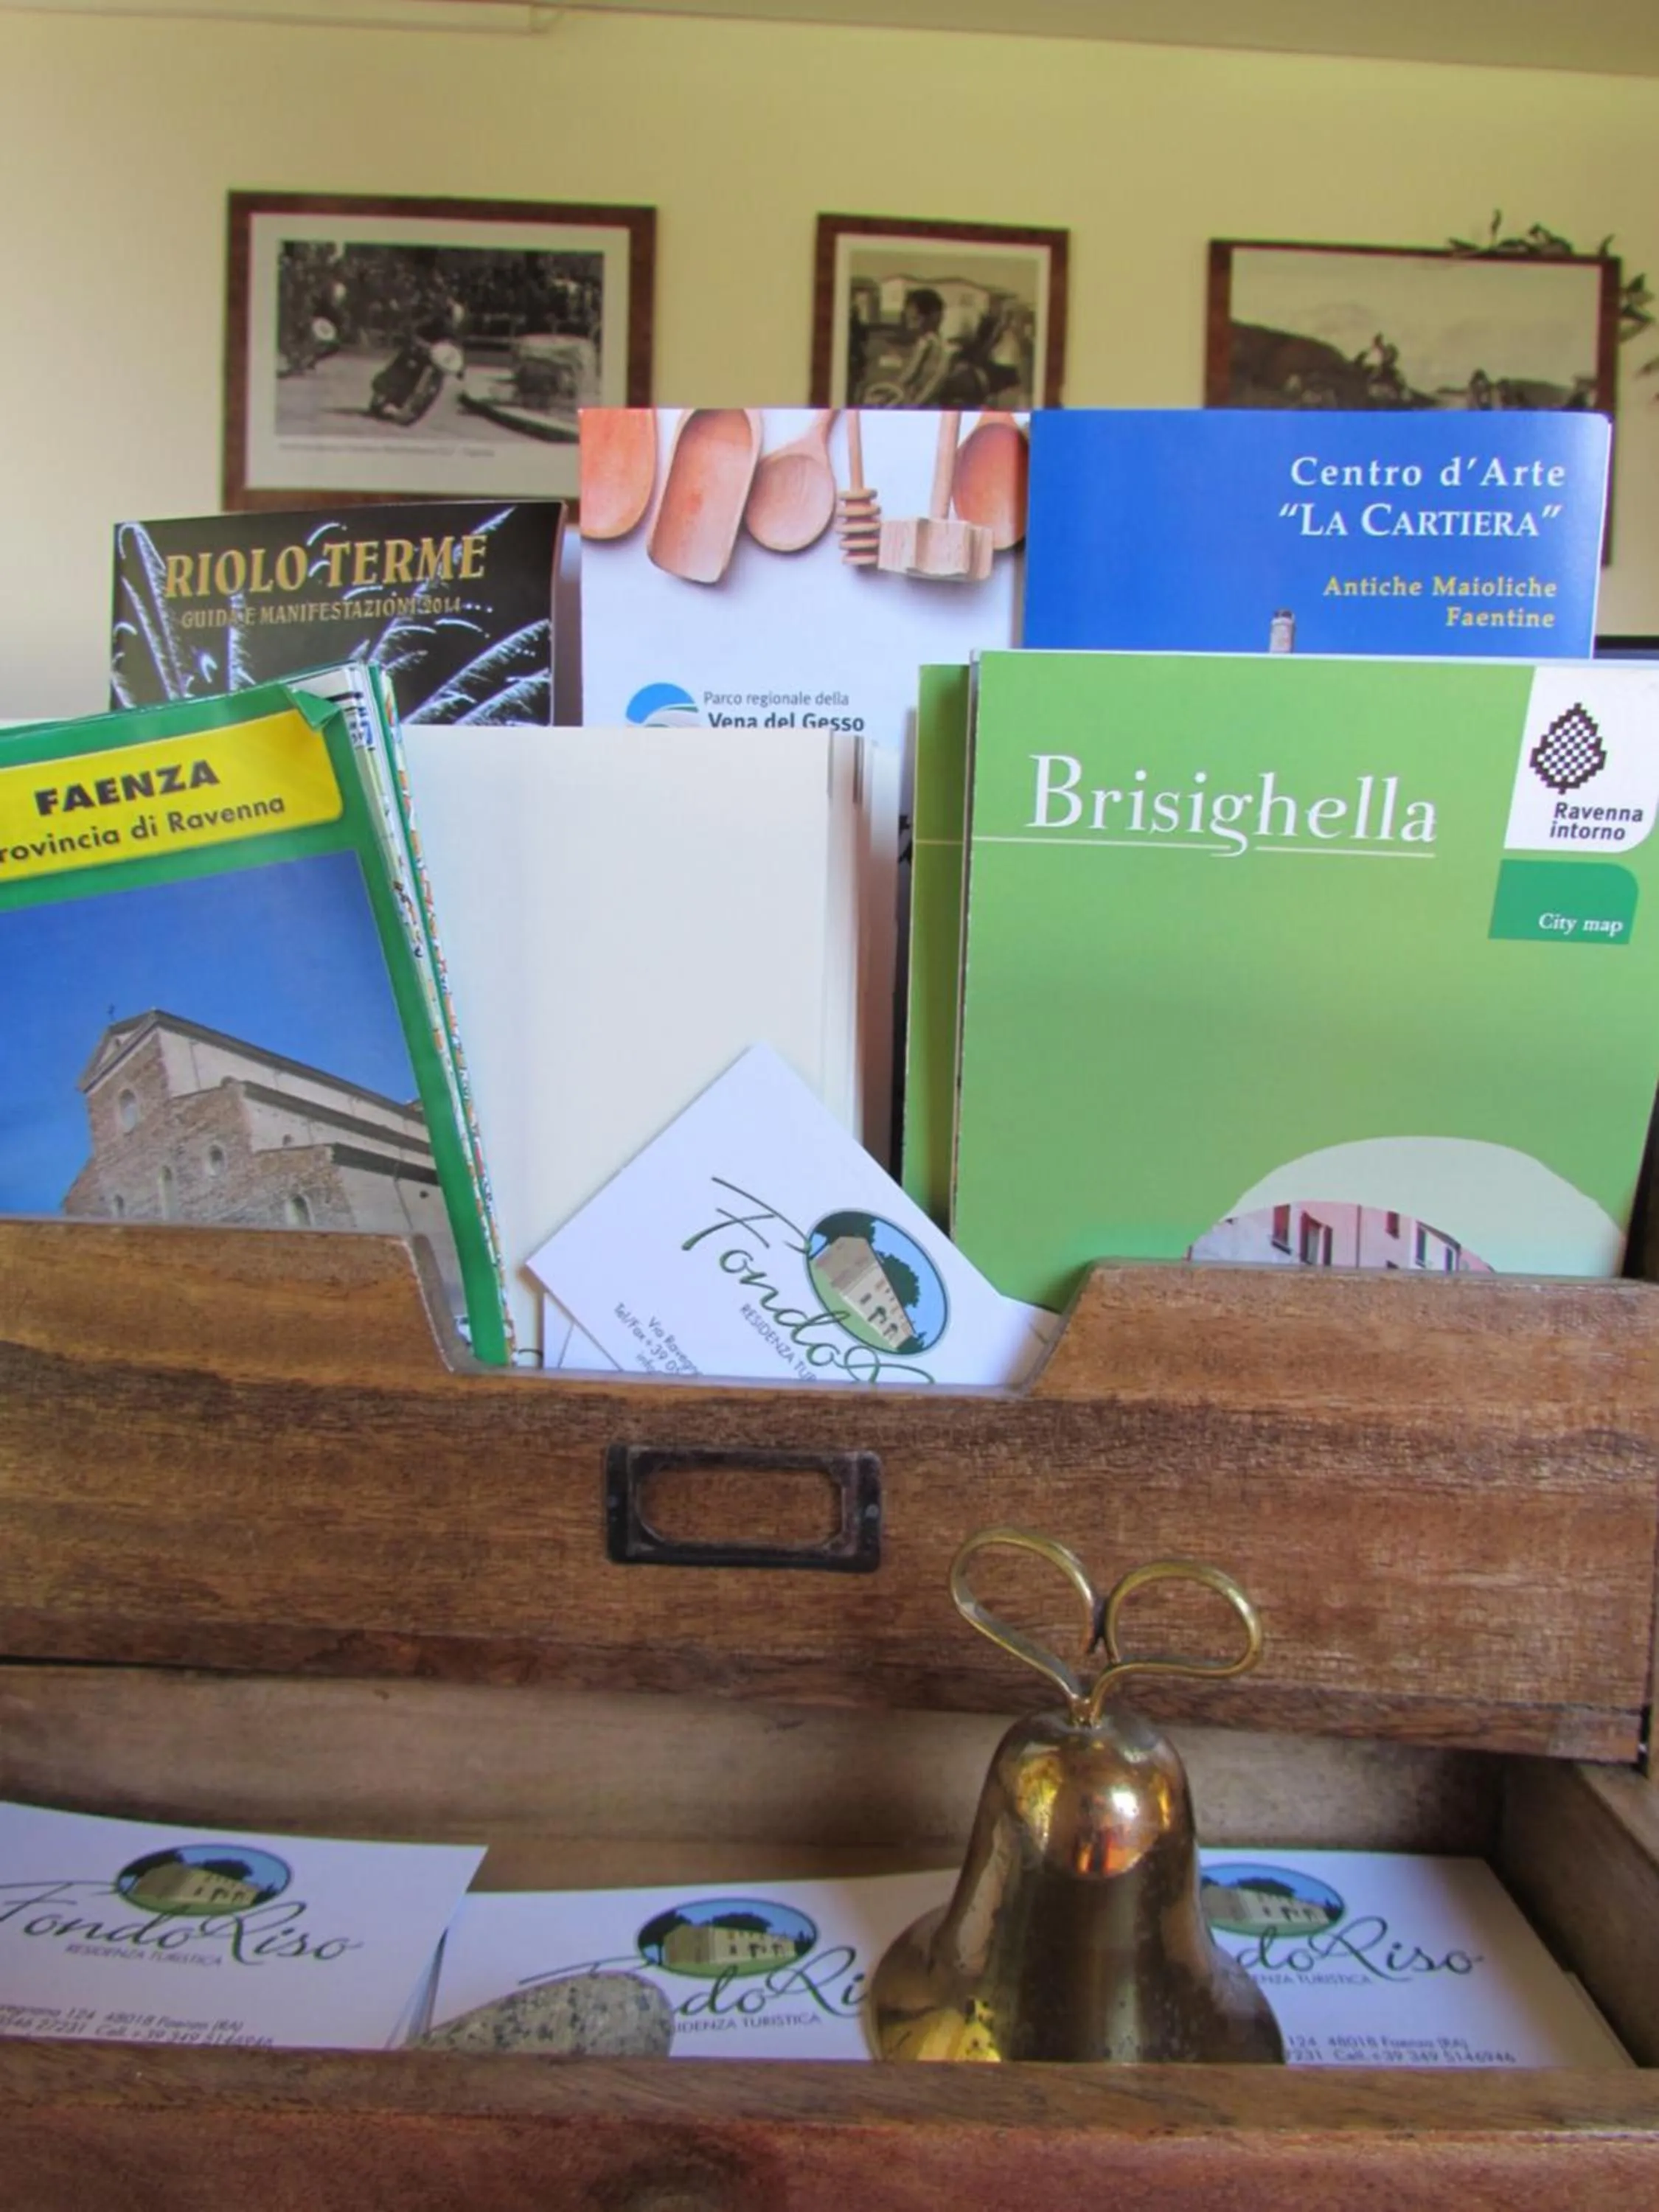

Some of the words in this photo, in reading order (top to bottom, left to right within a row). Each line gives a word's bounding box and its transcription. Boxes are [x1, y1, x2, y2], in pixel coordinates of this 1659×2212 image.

[1290, 456, 1422, 487] Centro
[1440, 456, 1566, 487] d'Arte
[164, 545, 309, 599] RIOLO
[324, 534, 488, 587] TERME
[1324, 576, 1422, 597] Antiche
[1432, 576, 1557, 598] Maioliche
[181, 607, 237, 629] GUIDA
[260, 598, 417, 626] MANIFESTAZIONI
[422, 597, 462, 615] 2014
[1446, 607, 1556, 628] Faentine
[703, 691, 742, 706] Parco
[746, 691, 811, 710] regionale
[815, 691, 849, 706] della
[708, 712, 758, 728] Vena
[765, 712, 795, 728] del
[803, 712, 865, 731] Gesso
[35, 759, 220, 818] FAENZA
[130, 815, 158, 839] di
[168, 796, 286, 834] Ravenna
[1023, 754, 1438, 858] Brisighella
[1554, 801, 1644, 822] Ravenna
[1549, 821, 1626, 841] intorno
[1538, 912, 1576, 935] City
[1582, 919, 1623, 937] map
[681, 1176, 851, 1367] Fondo
[740, 1304, 795, 1364] RESIDENZA
[675, 2016, 737, 2034] IDENZA
[742, 2011, 822, 2029] TURISTICA
